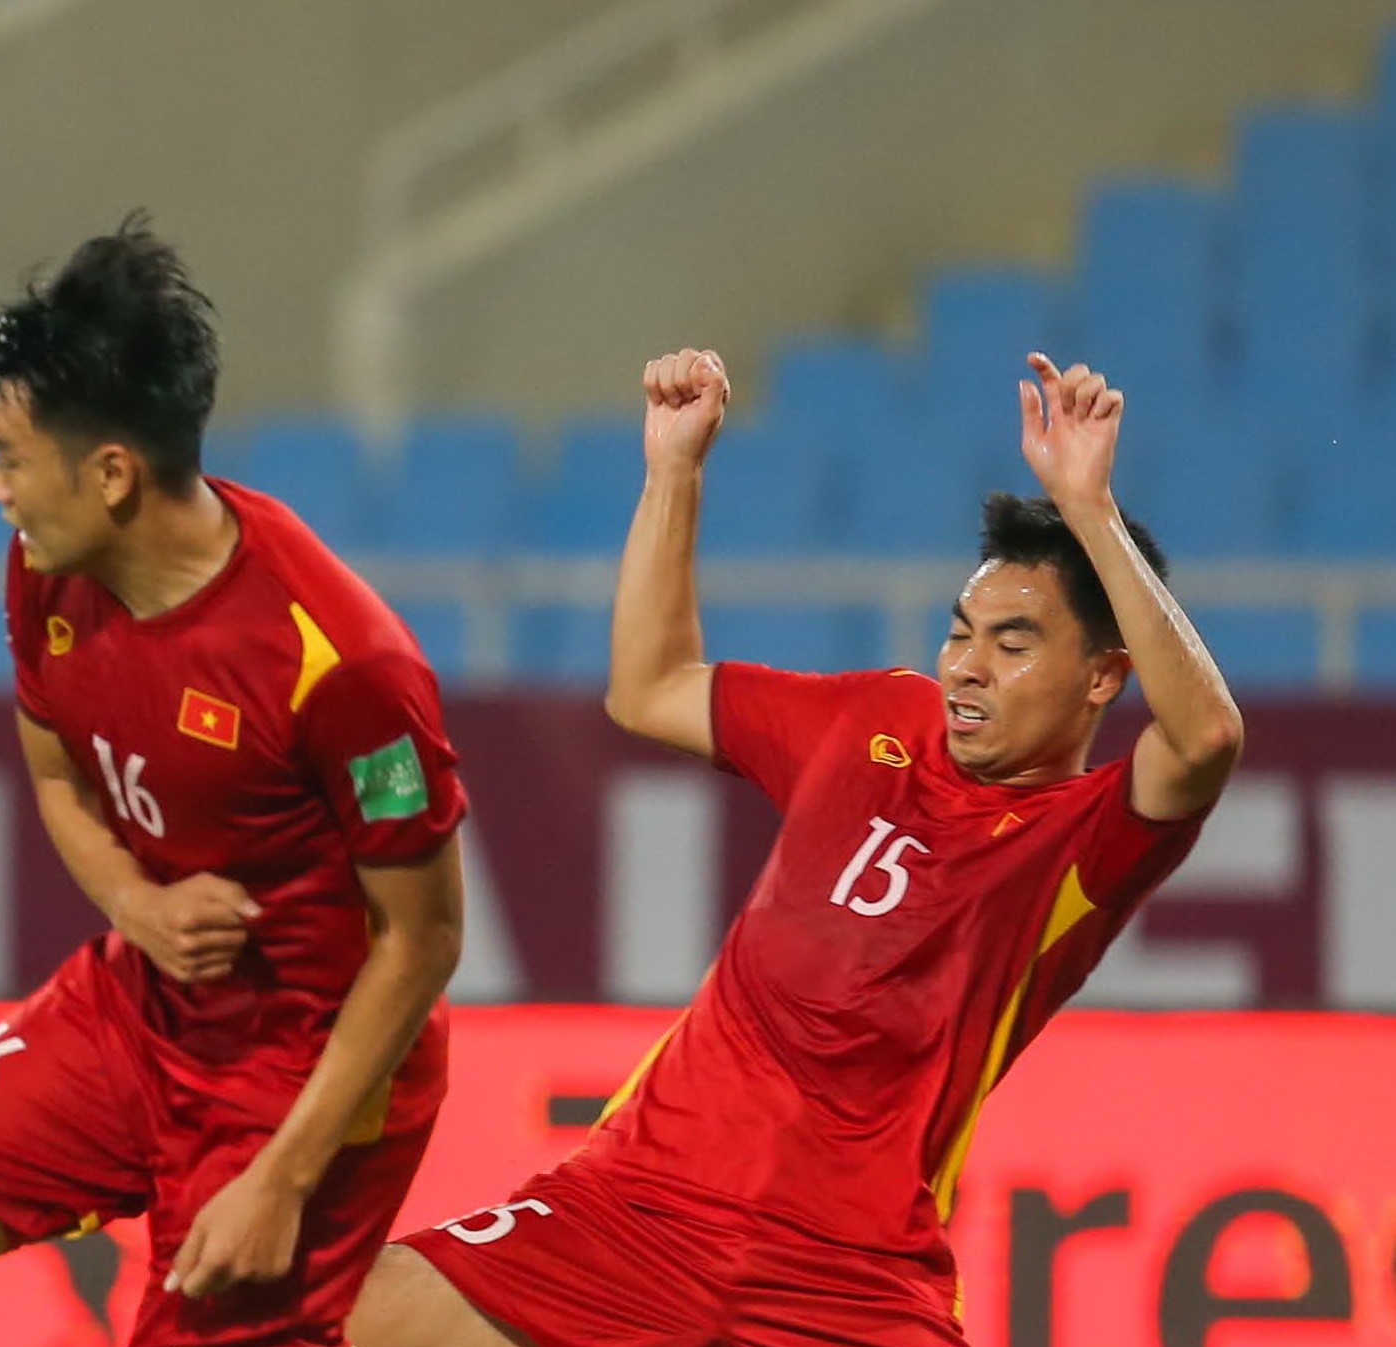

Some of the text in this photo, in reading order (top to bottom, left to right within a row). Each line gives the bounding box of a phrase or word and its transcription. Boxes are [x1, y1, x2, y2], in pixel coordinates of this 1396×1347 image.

[91, 732, 165, 839] 16
[829, 815, 931, 918] 15
[433, 1198, 554, 1245] 5
